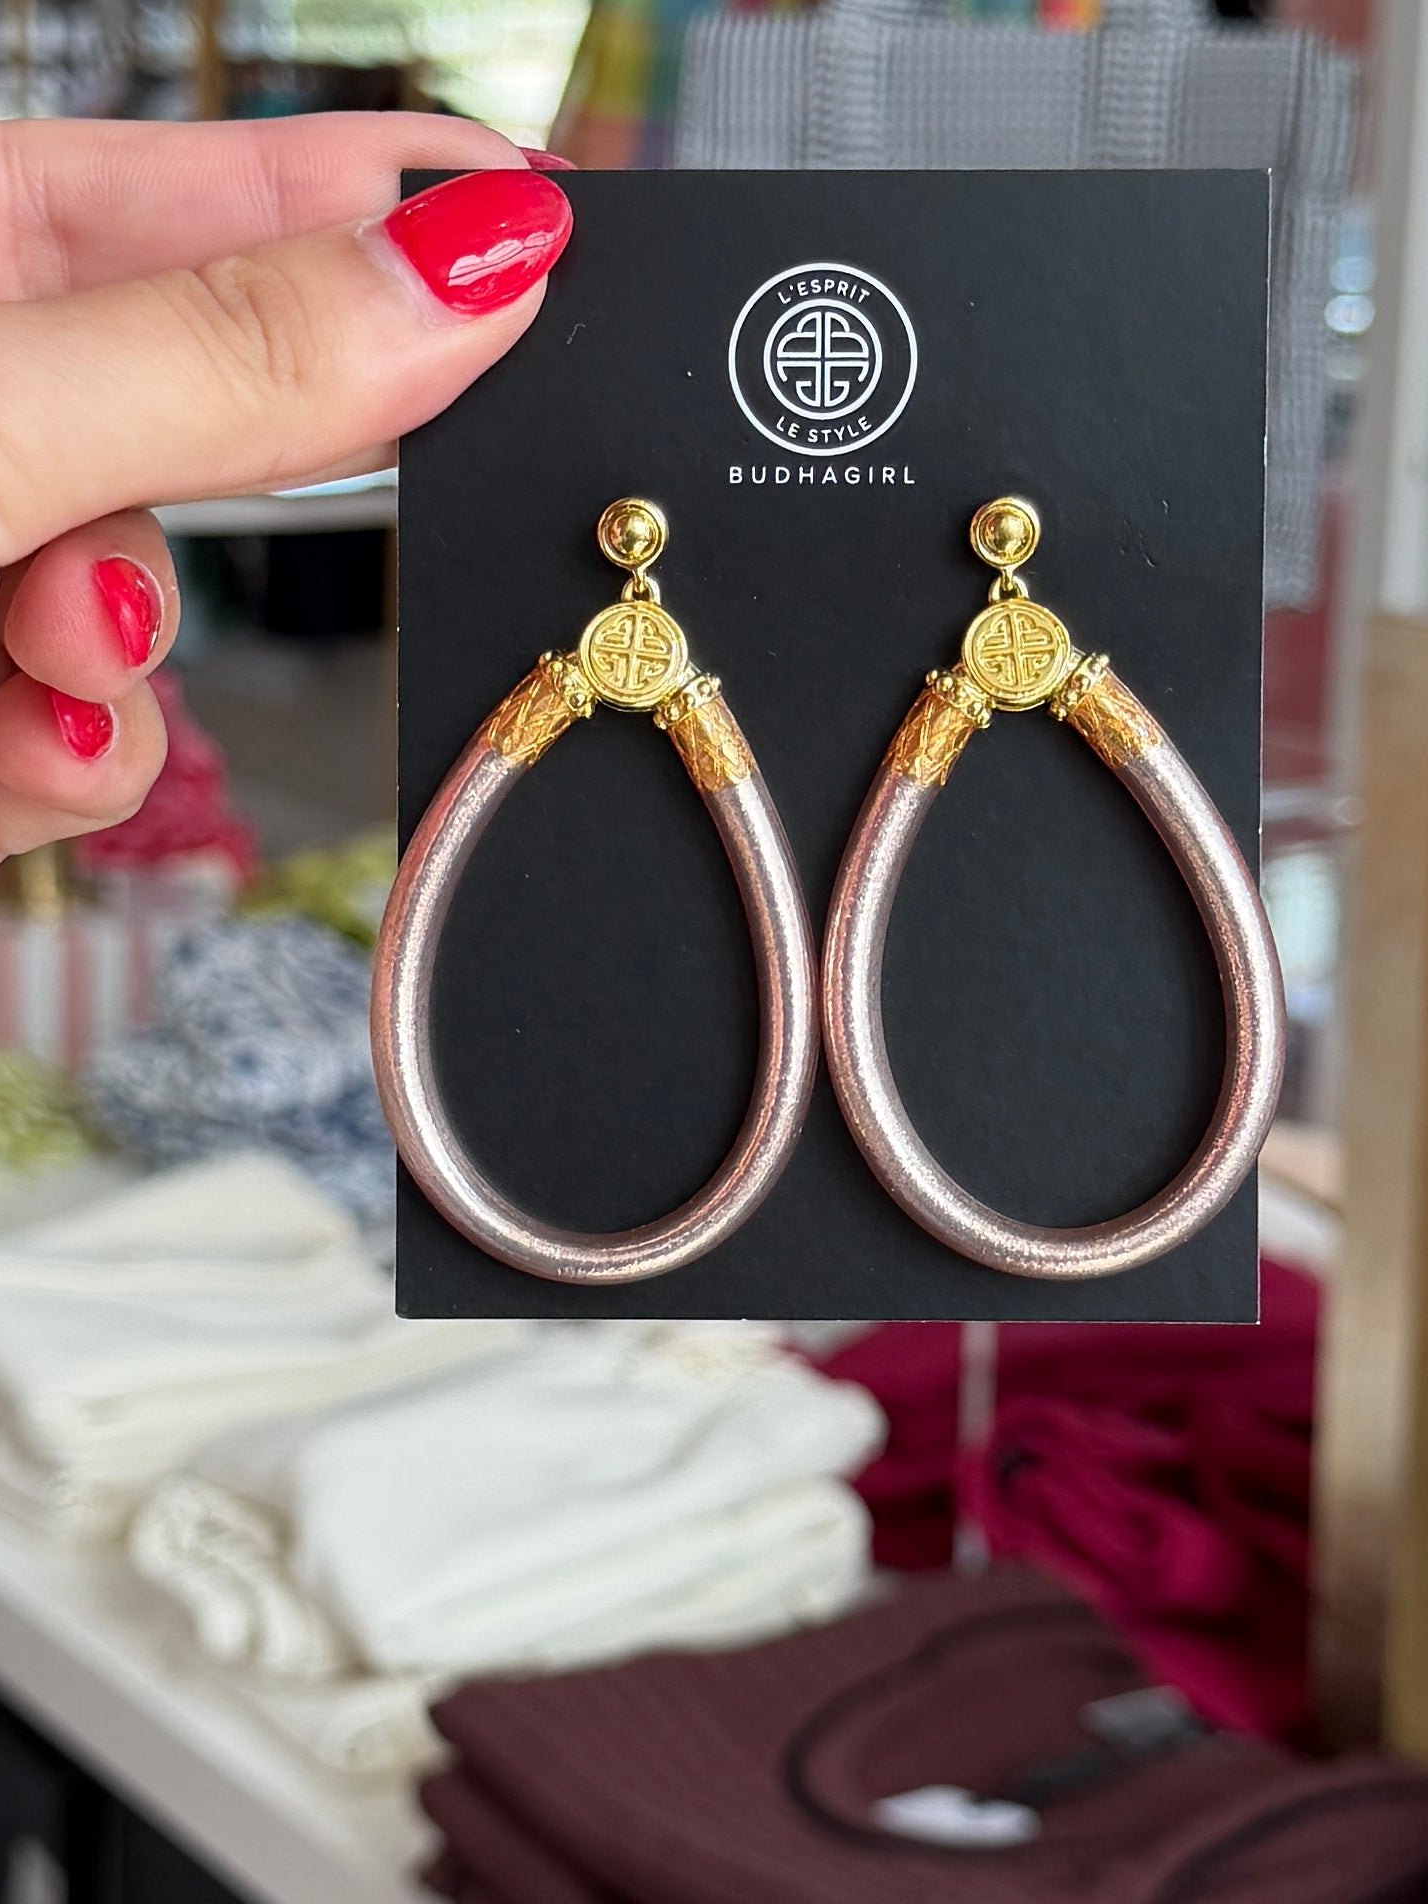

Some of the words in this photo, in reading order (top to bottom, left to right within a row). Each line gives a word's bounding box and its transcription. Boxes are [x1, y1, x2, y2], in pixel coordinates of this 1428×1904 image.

[777, 279, 870, 305] L'ESPRIT
[776, 416, 800, 439] LE
[807, 415, 872, 444] STYLE
[728, 466, 916, 485] BUDHAGIRL
